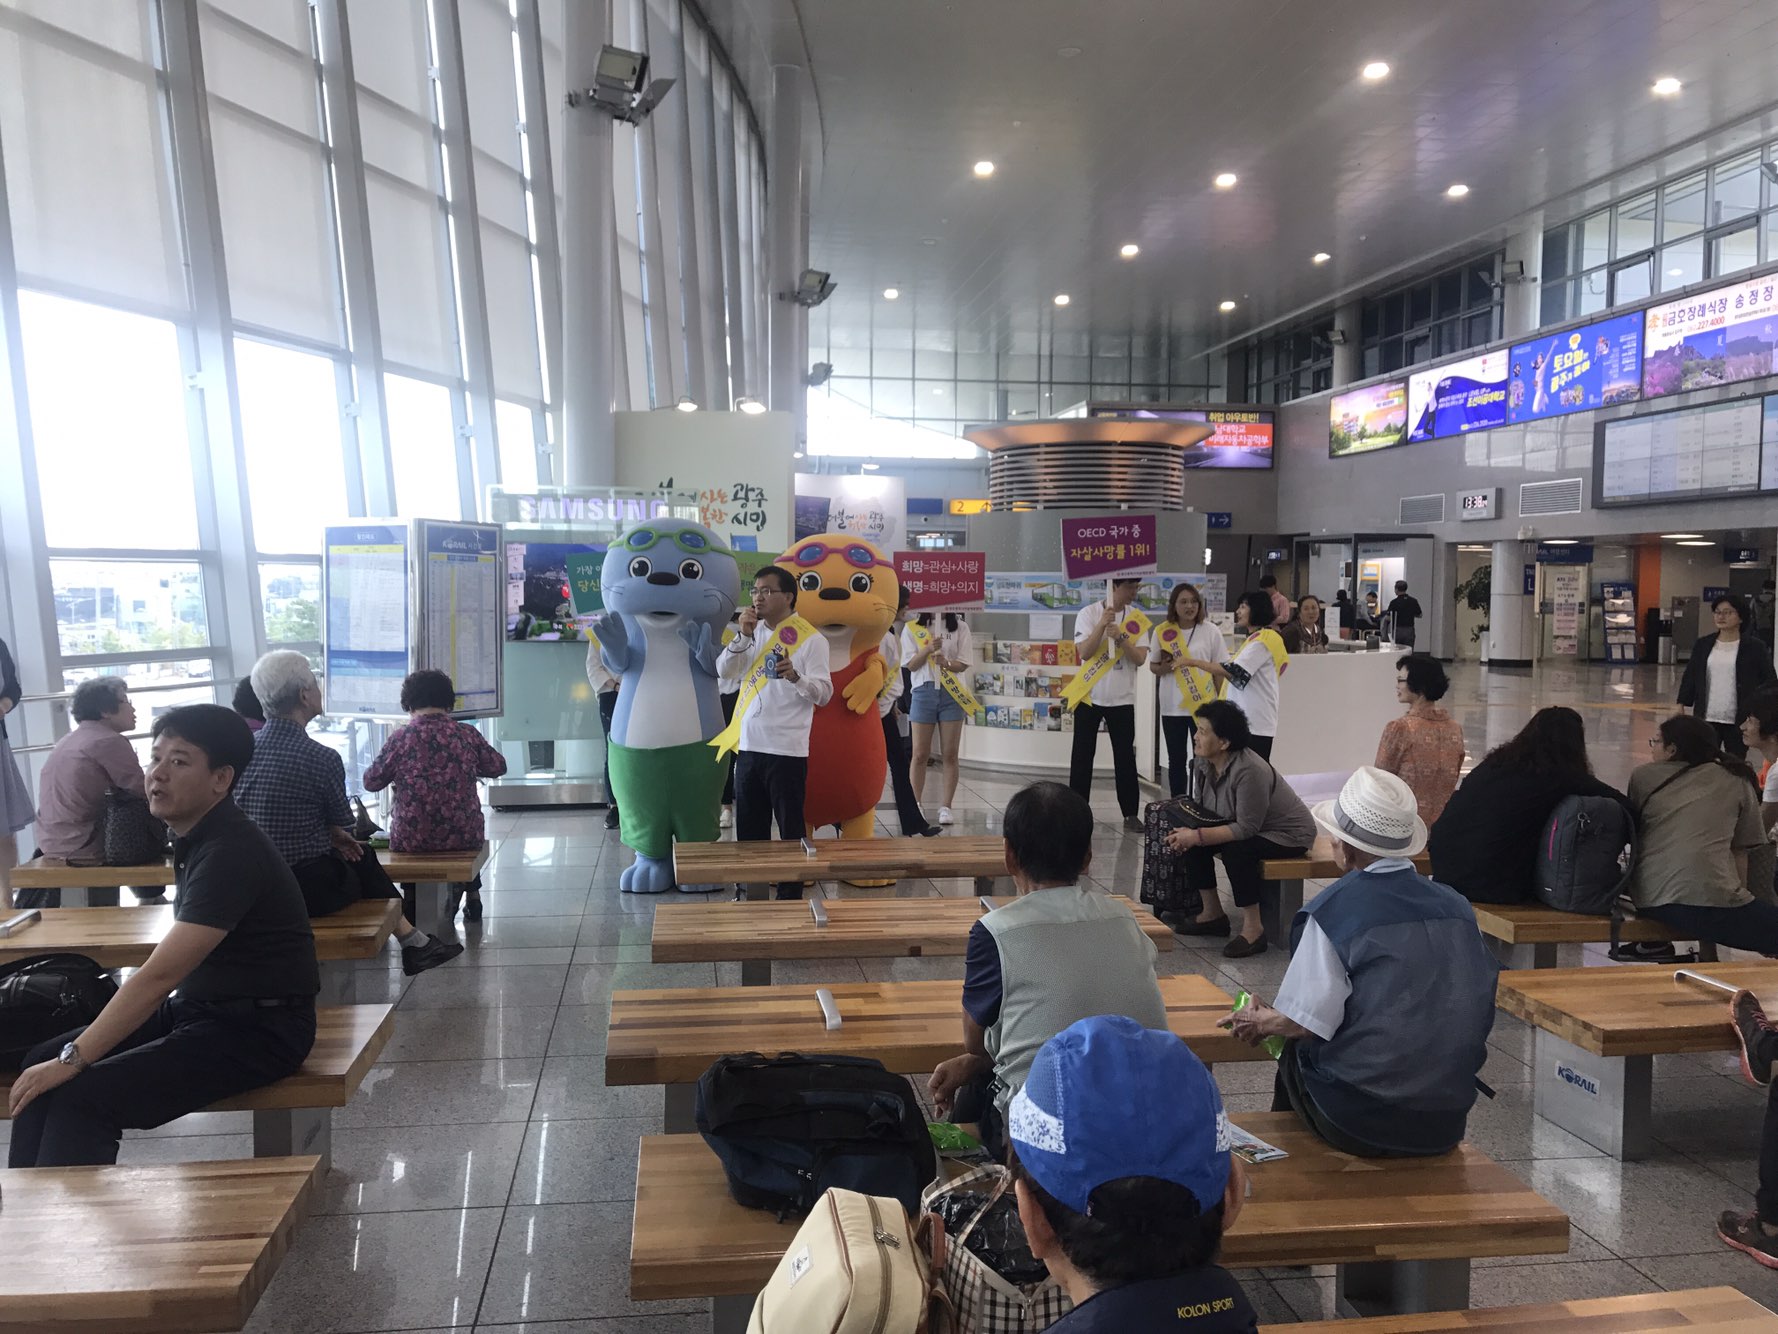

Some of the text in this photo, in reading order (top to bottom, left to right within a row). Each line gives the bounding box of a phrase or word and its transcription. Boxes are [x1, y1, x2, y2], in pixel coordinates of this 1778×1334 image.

[1668, 297, 1728, 327] 금호장례식장
[1209, 412, 1260, 423] 취업 아우토반!
[731, 483, 768, 509] 광주
[957, 501, 964, 512] 2
[731, 510, 767, 532] 시민
[1077, 524, 1141, 539] OECD 국가 중
[1070, 543, 1150, 561] 자살사망률 1위!
[576, 564, 593, 576] 가장
[902, 560, 979, 574] 희망=관심+사랑
[1557, 1065, 1598, 1095] KORAIL
[1177, 1297, 1235, 1319] KOLON SPORT
